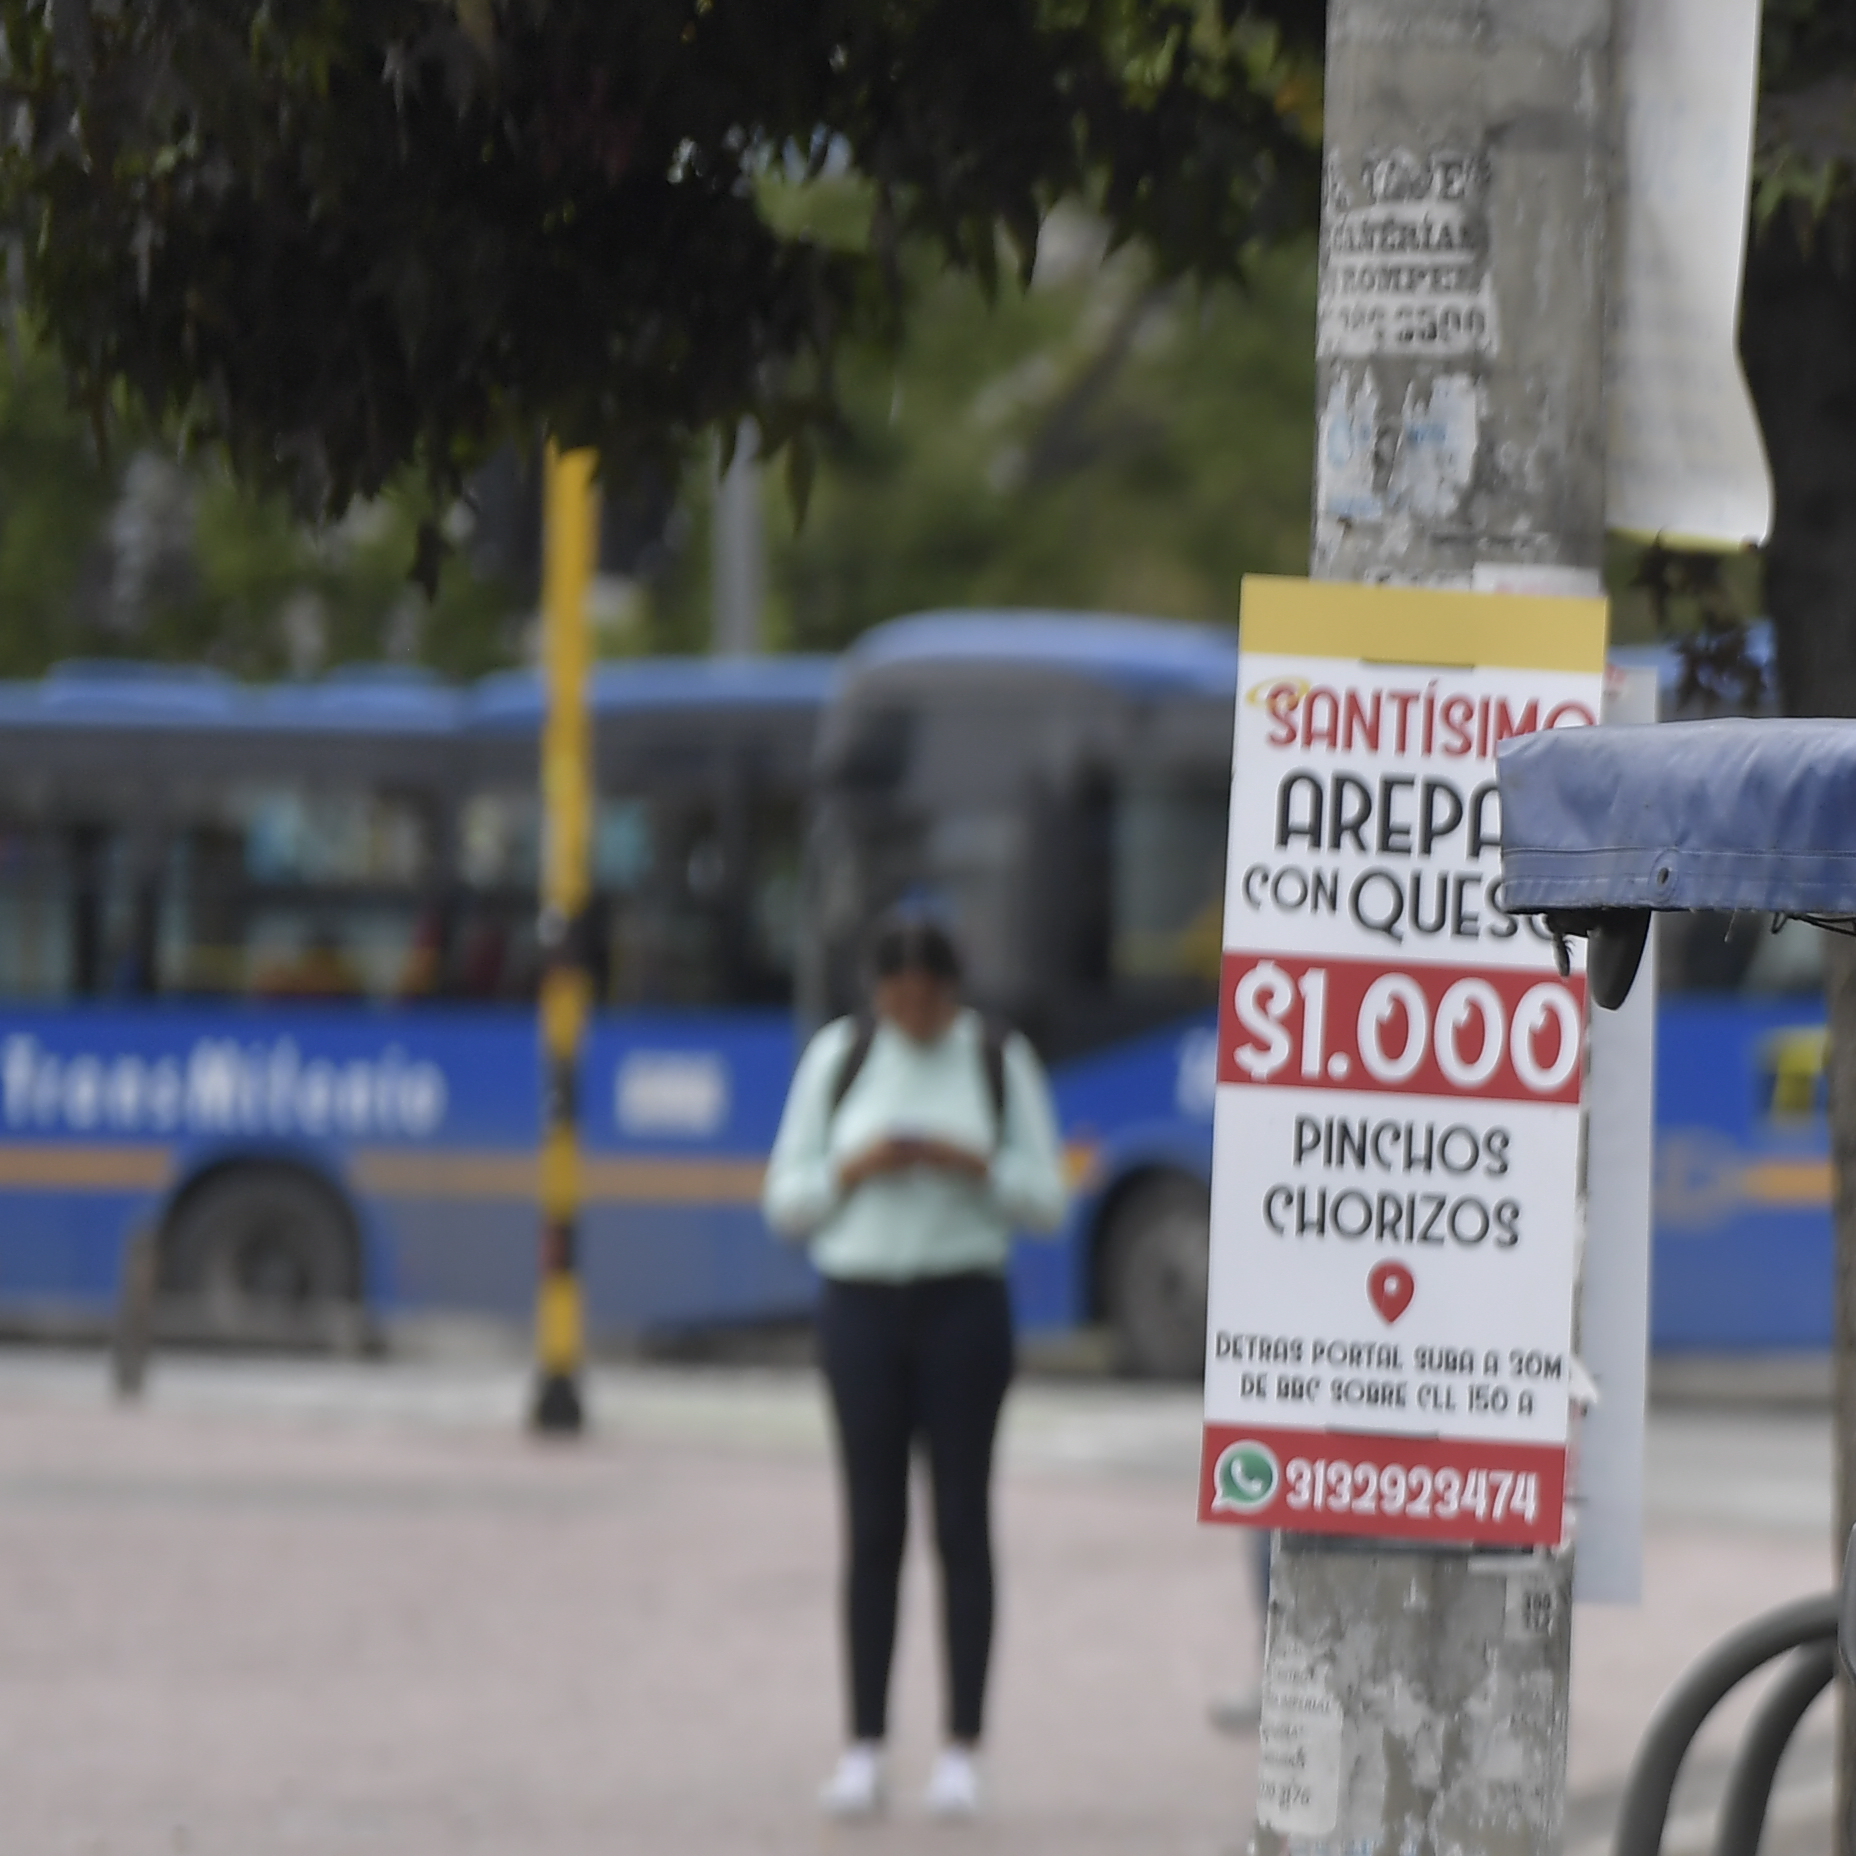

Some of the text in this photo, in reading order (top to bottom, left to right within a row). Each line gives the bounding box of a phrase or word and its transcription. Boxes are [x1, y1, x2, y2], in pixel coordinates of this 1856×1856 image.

[1242, 864, 1339, 916] CON
[1232, 958, 1581, 1094] $1.000
[1, 1031, 449, 1138] TransMilenio
[1292, 1113, 1511, 1178] PINCHOS
[1262, 1185, 1521, 1250] CHORIZOS
[1215, 1331, 1304, 1363] DETRAS
[1311, 1338, 1404, 1371] PORTAL
[1412, 1344, 1475, 1376] SUBA
[1481, 1349, 1499, 1377] A
[1239, 1372, 1535, 1417] DE BBC SOBRE CLL 150 A
[1283, 1456, 1538, 1525] 3132923474
